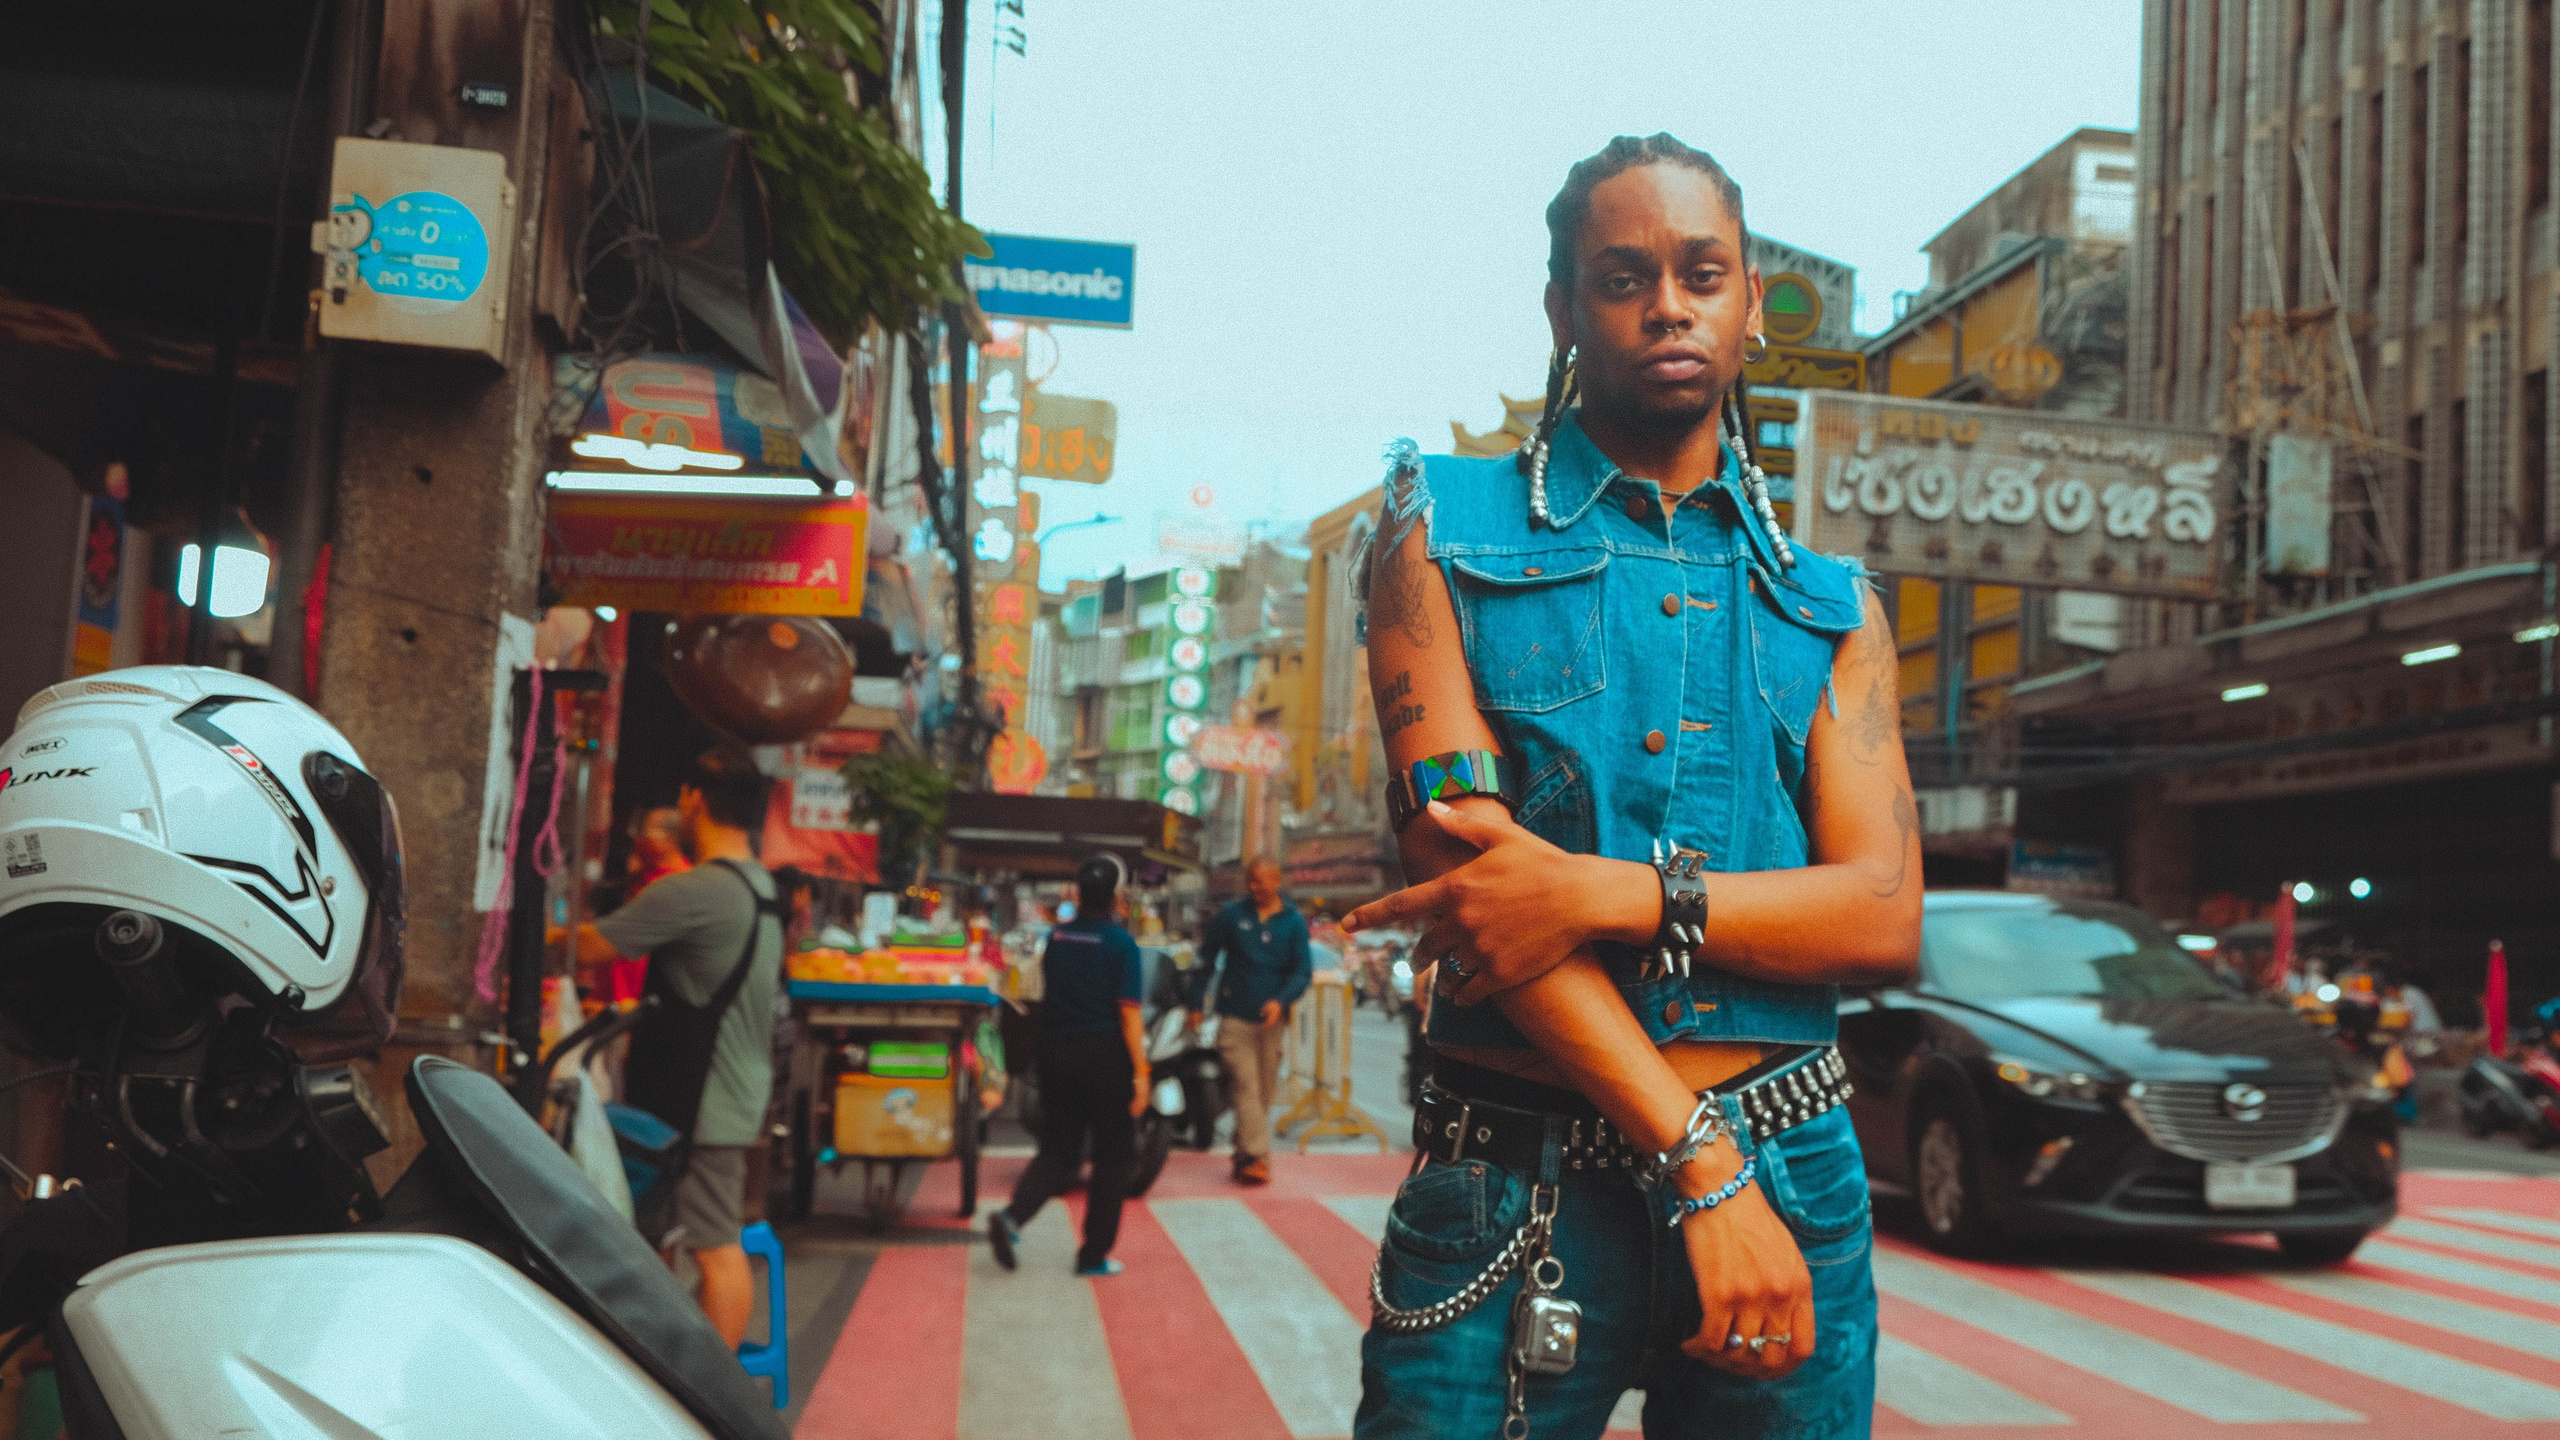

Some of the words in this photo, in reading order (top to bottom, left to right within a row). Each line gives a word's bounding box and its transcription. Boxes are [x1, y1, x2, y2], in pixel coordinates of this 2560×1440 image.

[420, 221, 440, 244] 0
[416, 272, 466, 293] 50%
[962, 263, 1123, 301] anasonic
